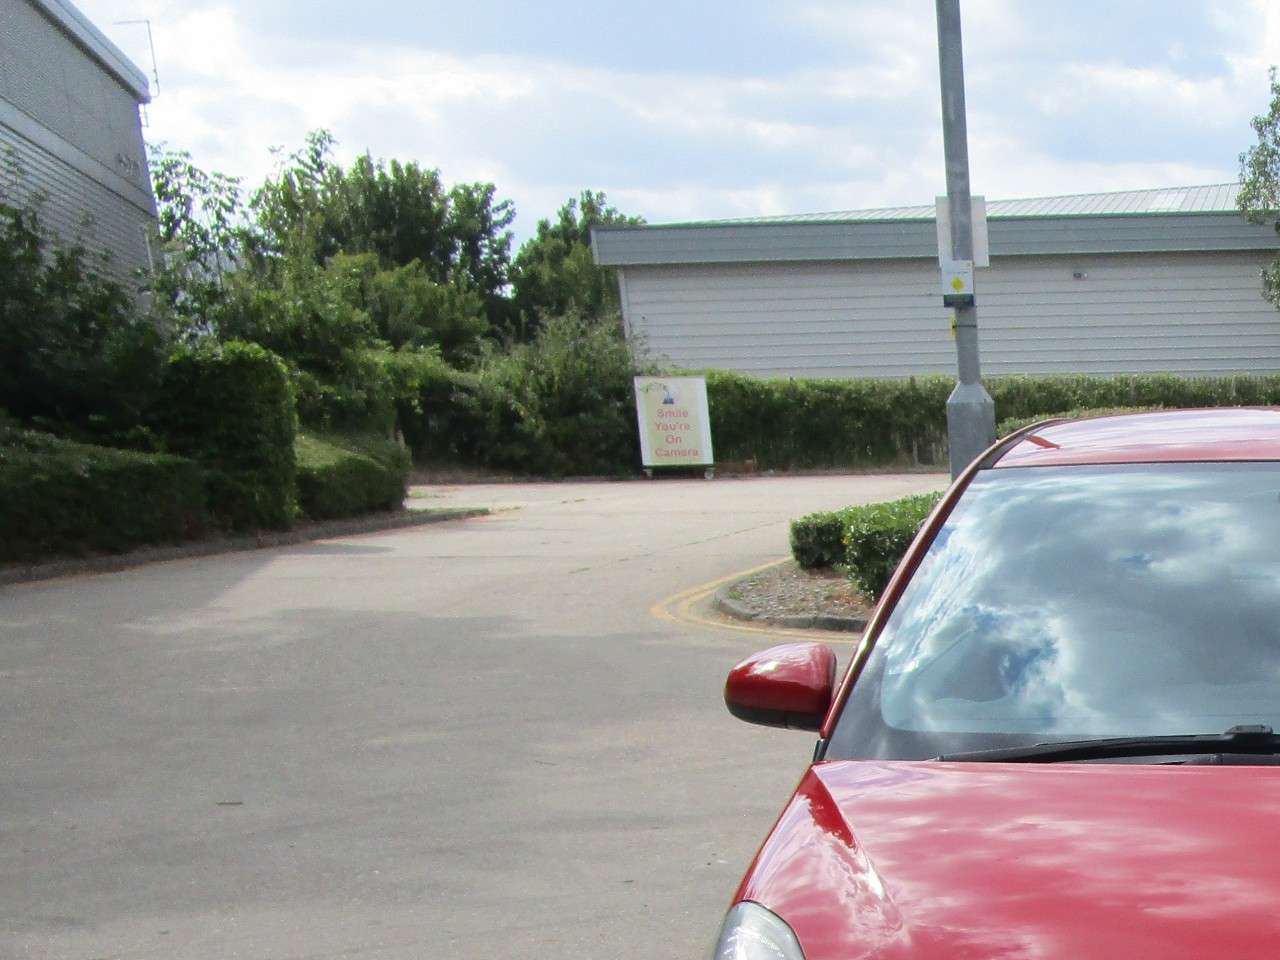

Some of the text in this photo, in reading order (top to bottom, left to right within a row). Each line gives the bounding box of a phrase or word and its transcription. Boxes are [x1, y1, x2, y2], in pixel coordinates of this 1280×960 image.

[656, 408, 689, 419] Smile
[665, 434, 682, 445] On
[655, 447, 699, 458] Camera
